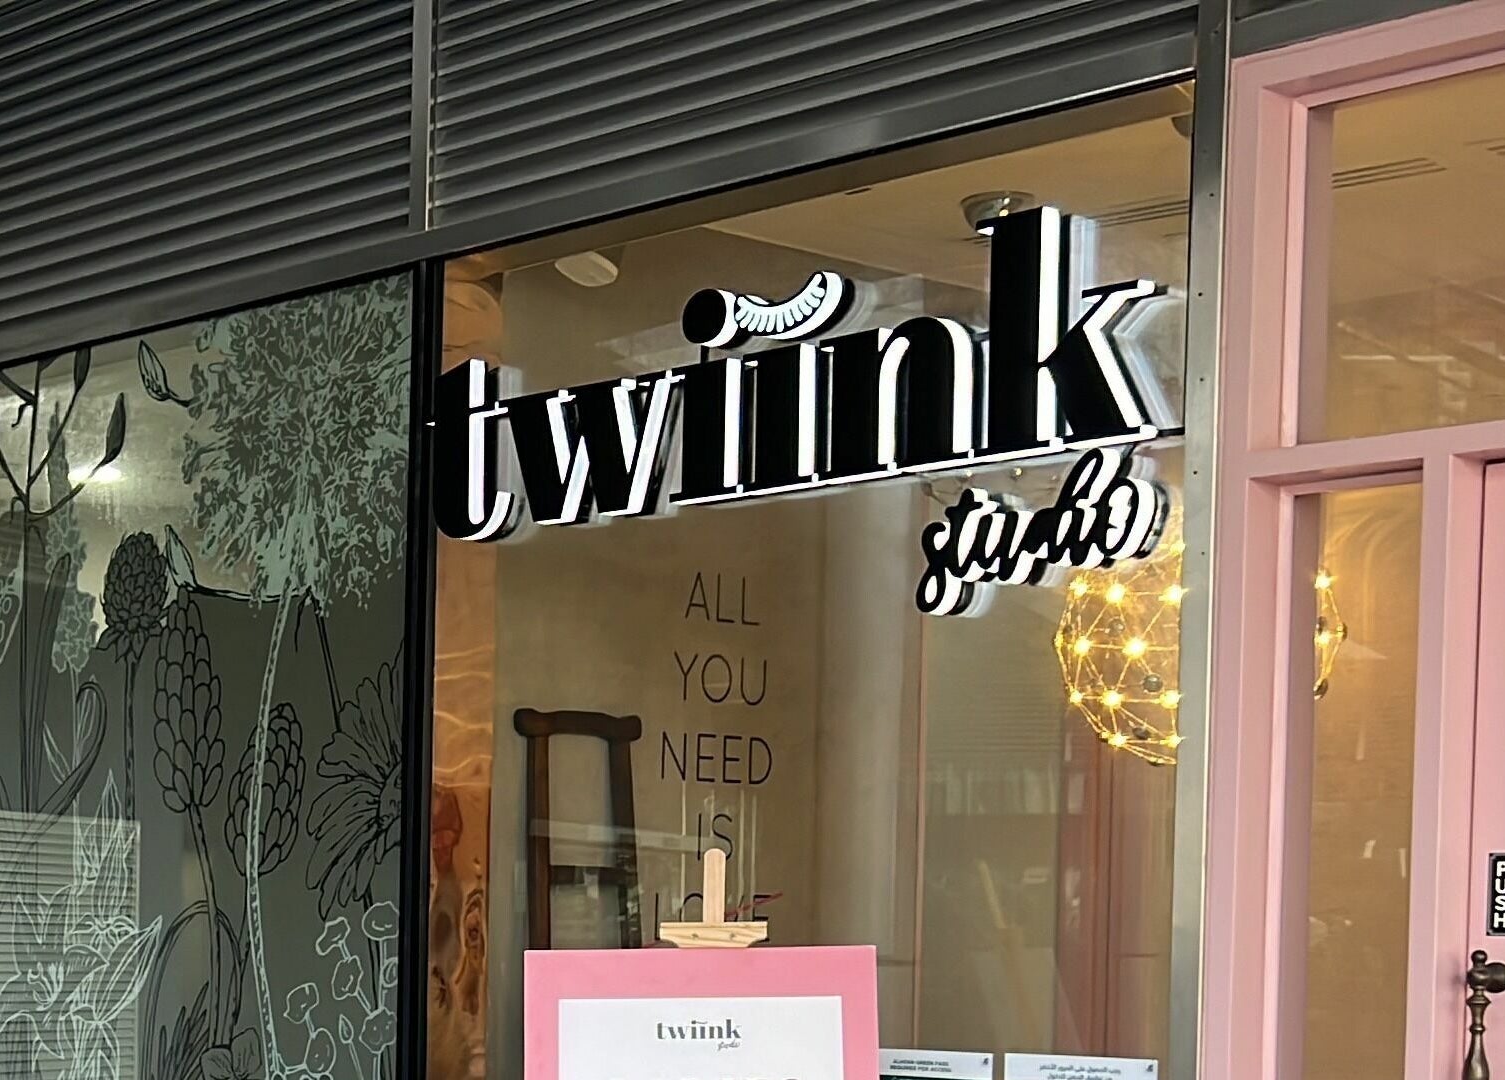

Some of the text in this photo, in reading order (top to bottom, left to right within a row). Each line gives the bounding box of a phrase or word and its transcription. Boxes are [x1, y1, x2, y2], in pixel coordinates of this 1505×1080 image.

[426, 205, 1159, 541] twiink
[916, 447, 1155, 617] studio
[685, 571, 761, 626] ALL
[673, 650, 768, 706] YOU
[660, 731, 773, 785] NEED
[697, 812, 733, 862] IS
